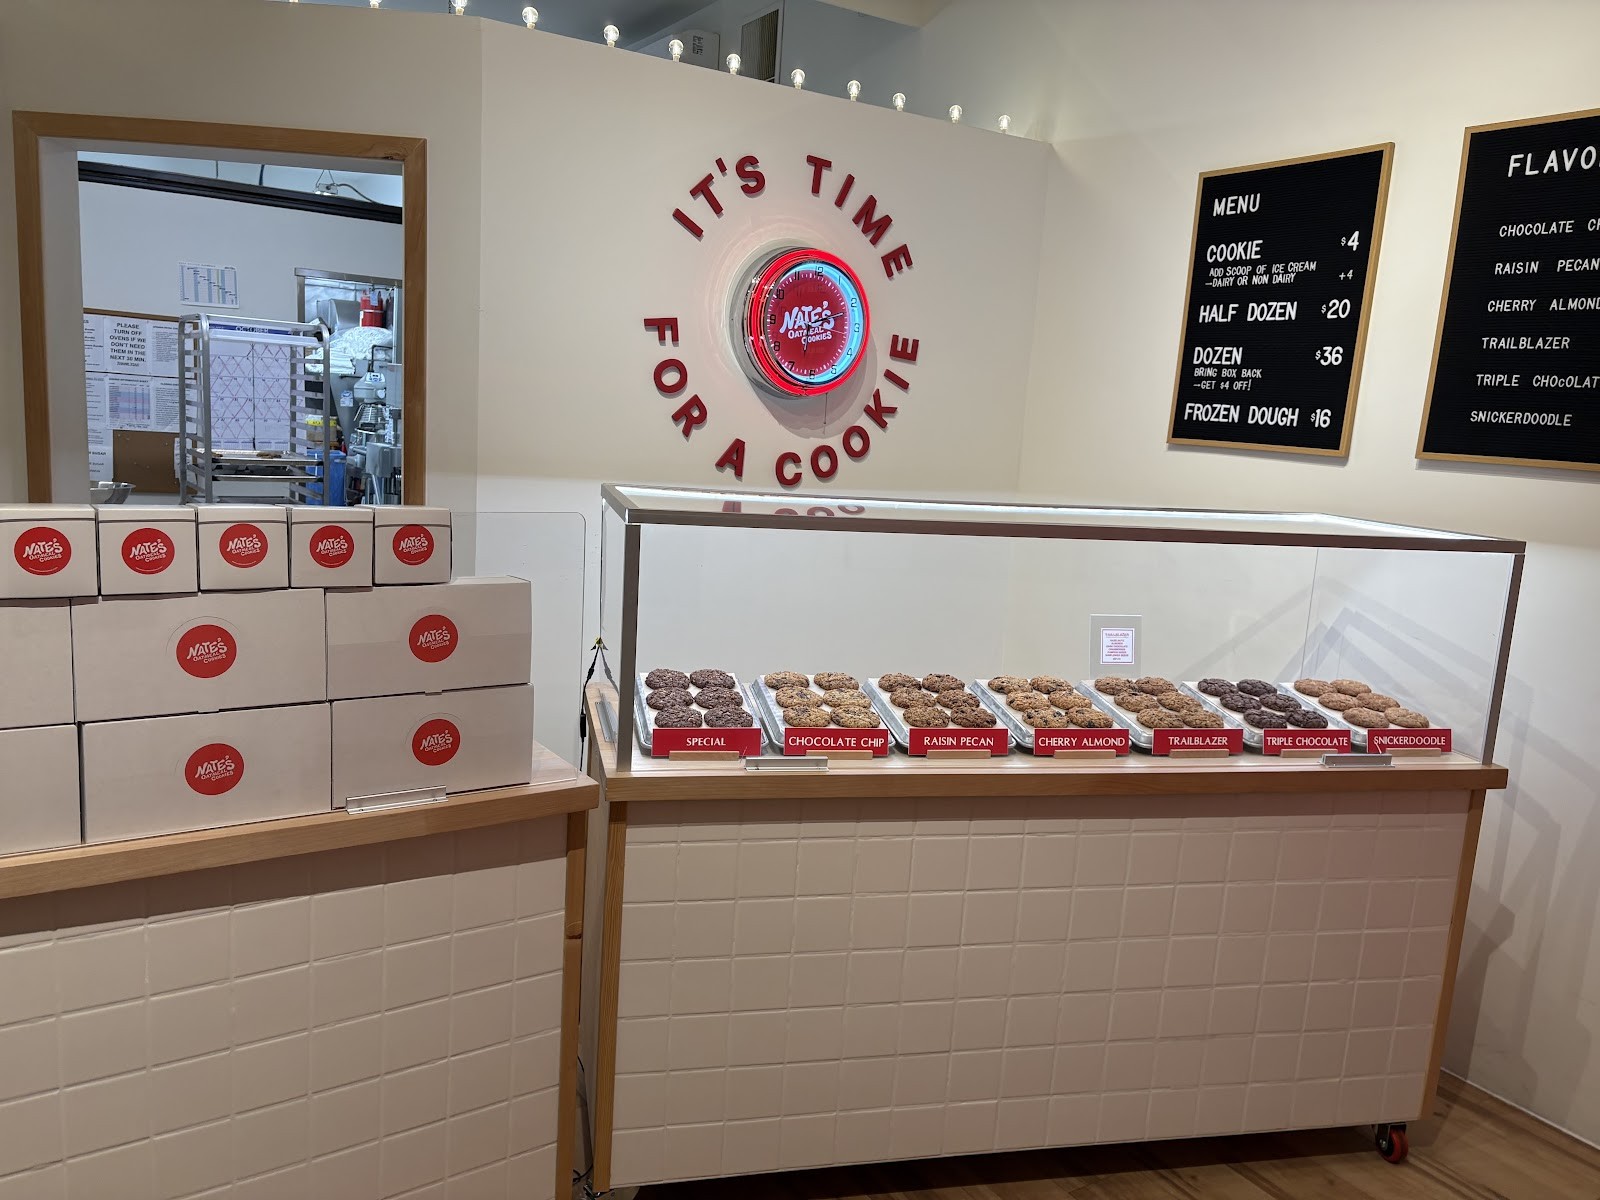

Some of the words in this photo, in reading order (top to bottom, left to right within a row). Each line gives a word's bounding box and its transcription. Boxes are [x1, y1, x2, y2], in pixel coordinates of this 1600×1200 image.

[1507, 146, 1600, 178] FLAVO
[1213, 193, 1261, 217] MENU
[672, 155, 766, 239] IT'S
[806, 154, 913, 279] TIME
[1499, 220, 1575, 238] CHOCOLATE
[1206, 240, 1263, 263] COOKIE
[1340, 231, 1360, 251] $4
[814, 266, 824, 277] 12
[1209, 267, 1224, 277] ADD
[1226, 265, 1252, 276] SCOOP
[1256, 265, 1267, 274] OF
[1272, 263, 1284, 274] ICE
[1287, 261, 1317, 272] CREAM
[1495, 261, 1539, 275] RAISIN
[1557, 258, 1600, 272] PECAN
[1237, 276, 1248, 286] OR
[1252, 274, 1269, 285] NON
[1272, 272, 1297, 284] DAIRY
[1339, 269, 1354, 281] +4
[851, 298, 857, 308] 2
[1199, 304, 1239, 323] HALF
[1246, 301, 1297, 322] DOZEN
[1321, 299, 1351, 319] $20
[1487, 299, 1537, 312] CHERRY
[770, 314, 776, 324] 9
[780, 301, 835, 334] NATE'S
[788, 326, 824, 339] OATMEAL
[854, 323, 860, 333] 3
[1482, 336, 1570, 350] TRAILBLAZER
[847, 348, 852, 357] 4
[1193, 347, 1243, 365] DOZEN
[1315, 346, 1344, 366] $36
[831, 365, 837, 375] 5
[1194, 368, 1218, 377] BRING
[1221, 368, 1237, 378] BOX
[1241, 368, 1262, 379] BACK
[1220, 381, 1230, 390] $4
[1233, 379, 1252, 391] OFF!
[1476, 374, 1520, 387] TRIPLE
[644, 317, 708, 438] FOR
[715, 438, 746, 478] A
[775, 334, 919, 487] COOKIE
[1184, 403, 1240, 424] FROZEN
[1248, 405, 1299, 427] DOUGH
[1310, 409, 1331, 428] $16
[1470, 410, 1573, 427] SNICKERDOODLE
[23, 537, 63, 558] NATE'S
[130, 538, 167, 558] NATE'S
[227, 534, 261, 551] NATE'S
[316, 535, 348, 552] NATE'S
[399, 533, 428, 550] NATE'S
[417, 626, 451, 646] NATE'S
[187, 638, 227, 659] NATE'S
[420, 730, 453, 750] NATE'S
[686, 737, 727, 746] SPECIAL
[788, 736, 856, 747] CHOCOLATE
[860, 737, 885, 748] CHIP
[923, 736, 957, 746] RAISIN
[960, 736, 994, 747] PECAN
[1038, 737, 1077, 747] CHERRY
[1082, 737, 1126, 747] ALMOND
[1168, 736, 1228, 746] TRAILBLAZER
[1266, 737, 1293, 746] TRIPLE
[1295, 736, 1348, 746] CHOCOLATE
[1373, 735, 1446, 746] SNICKERDOODLE
[195, 755, 235, 778] NATE'S
